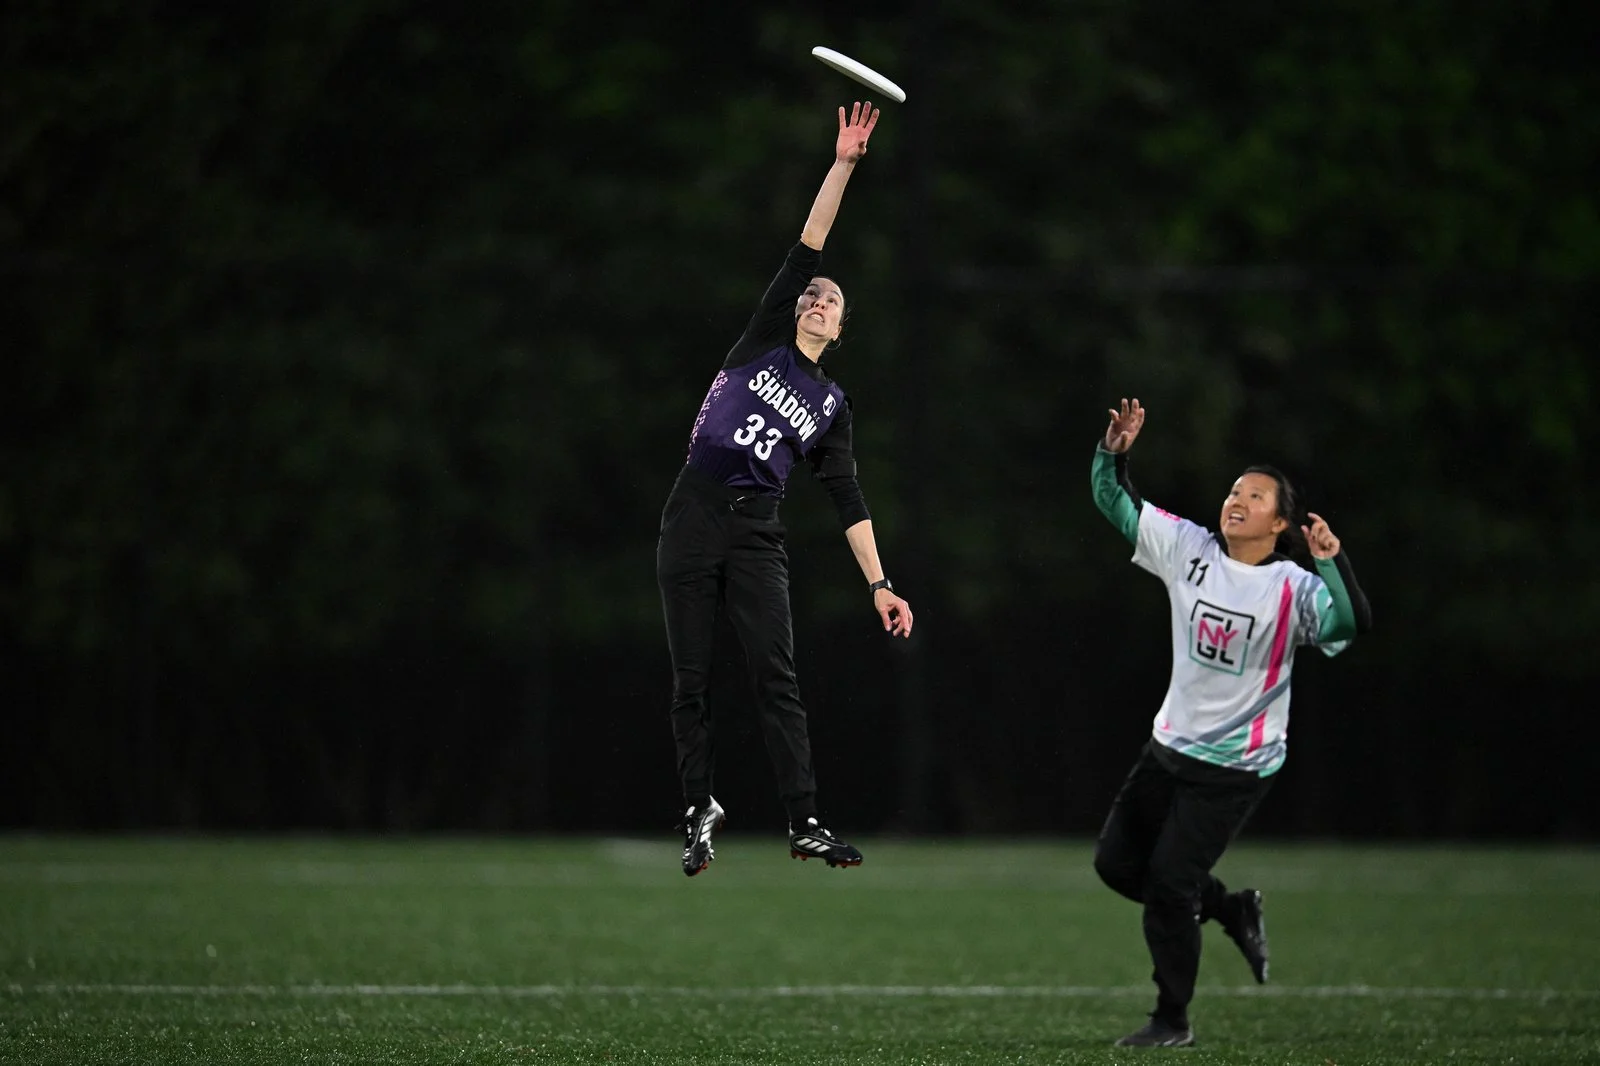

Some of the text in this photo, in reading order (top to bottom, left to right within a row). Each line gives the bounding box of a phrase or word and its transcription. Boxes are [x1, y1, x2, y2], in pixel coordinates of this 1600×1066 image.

[748, 370, 817, 442] SHADOW
[733, 413, 783, 461] 33
[1186, 557, 1209, 587] 11
